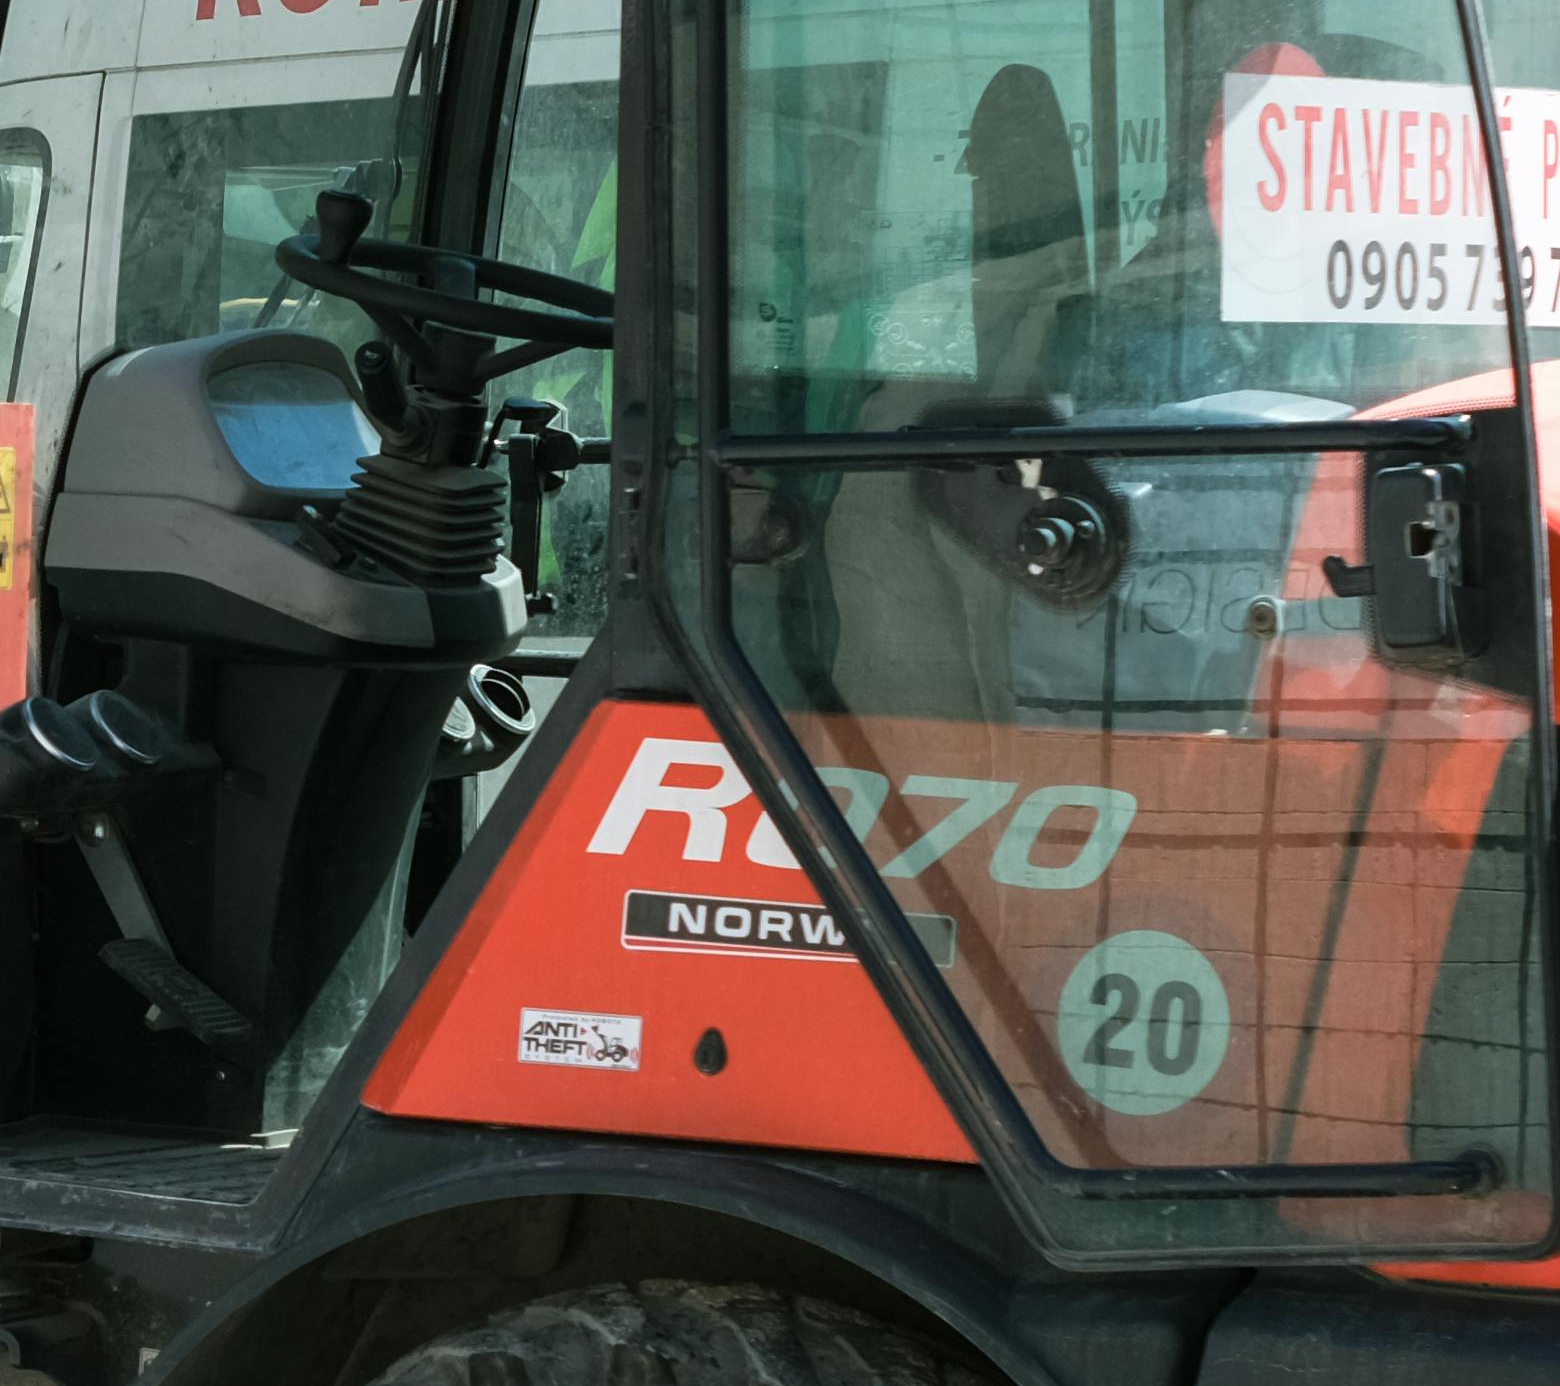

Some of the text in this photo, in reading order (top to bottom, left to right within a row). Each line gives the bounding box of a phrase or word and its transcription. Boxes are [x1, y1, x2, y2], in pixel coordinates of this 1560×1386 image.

[1326, 239, 1448, 312] 0905
[668, 902, 846, 946] NORW
[523, 1036, 587, 1056] THEFT
[524, 1020, 578, 1038] ANTI
[1082, 972, 1203, 1078] 20
